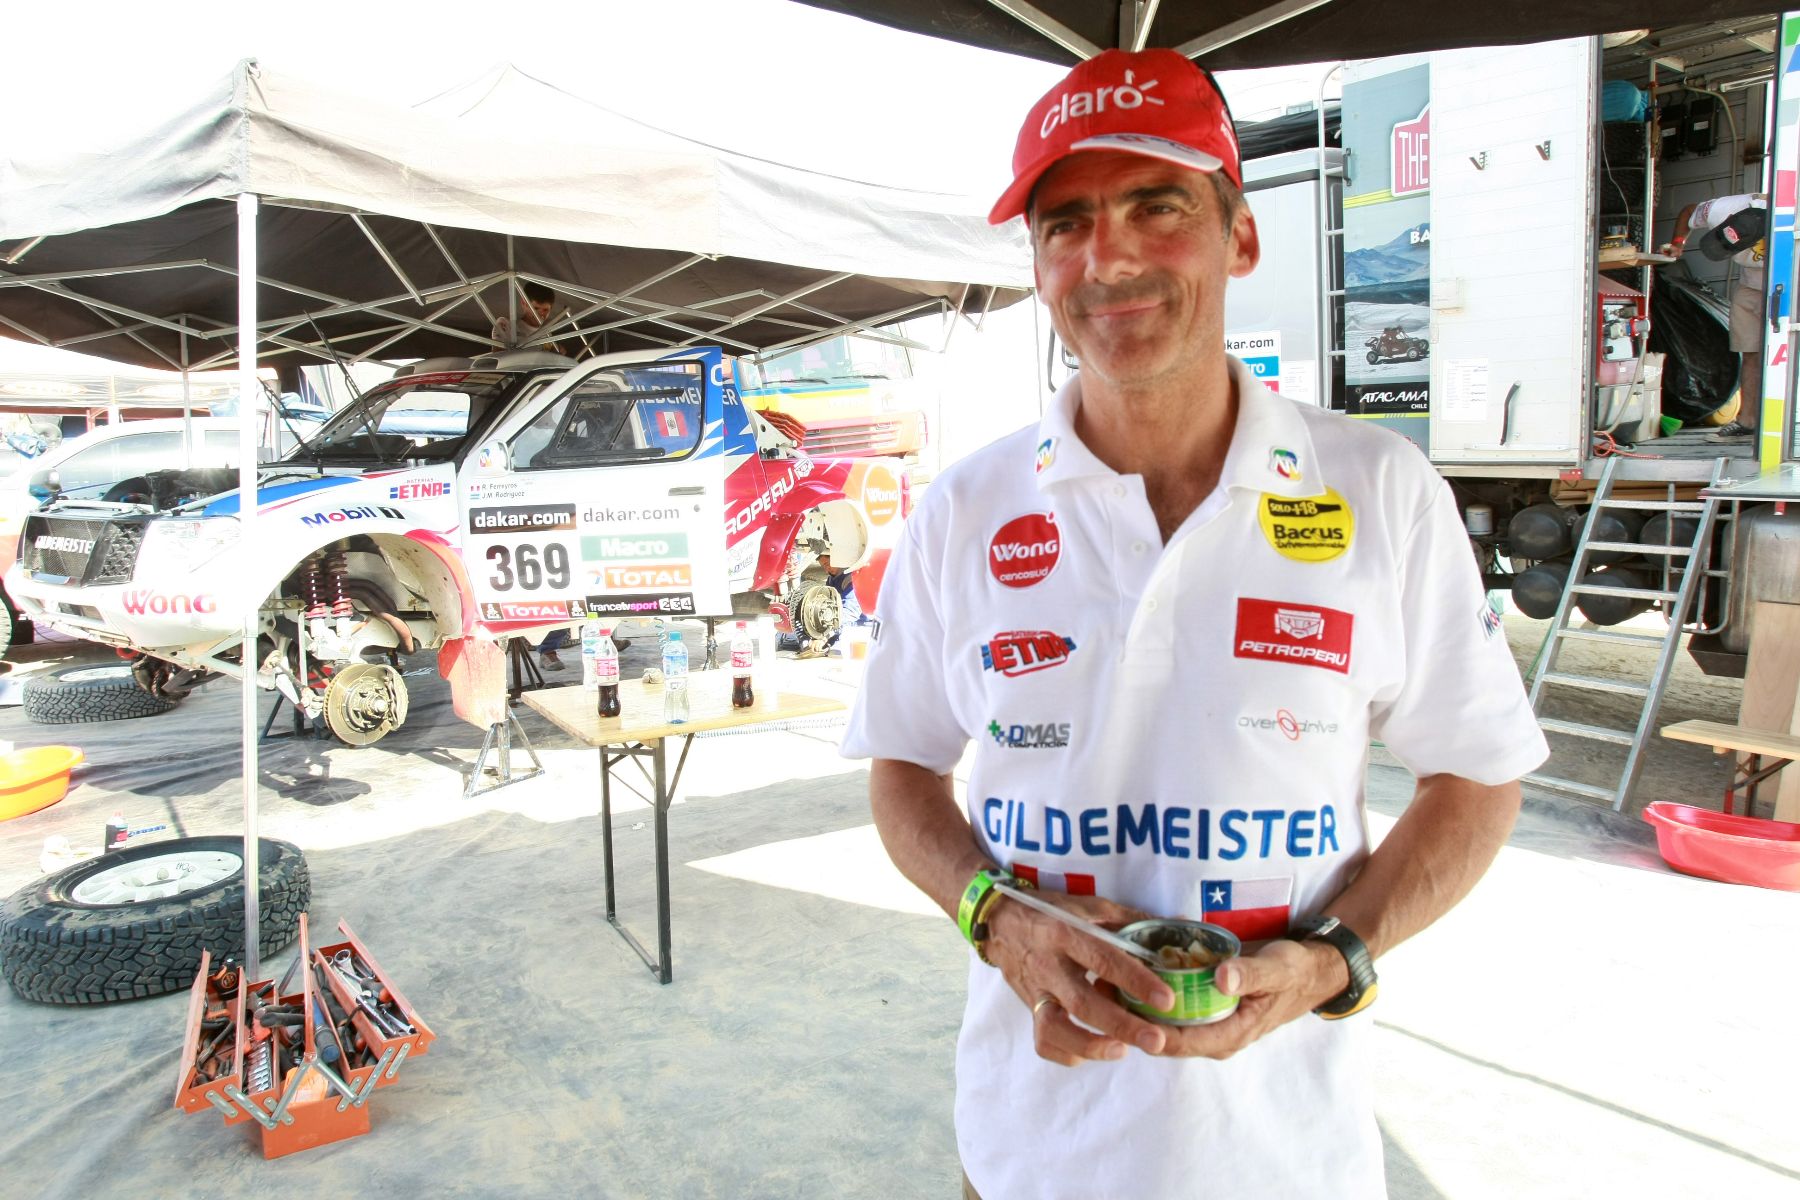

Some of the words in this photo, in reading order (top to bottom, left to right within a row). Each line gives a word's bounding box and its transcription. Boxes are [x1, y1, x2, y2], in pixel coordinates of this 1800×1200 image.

[1041, 85, 1144, 139] claro
[1398, 131, 1429, 188] THE
[1359, 390, 1429, 404] ATACAMA
[398, 482, 443, 500] ETNA
[724, 467, 795, 537] ROPERU
[300, 507, 377, 529] Mobil
[474, 510, 571, 528] dakar.com
[583, 507, 680, 522] dakar.com
[600, 538, 669, 556] Macro
[992, 539, 1058, 562] Wong
[486, 543, 571, 592] 369
[607, 569, 690, 585] TOTAL
[999, 566, 1050, 582] cencosud
[122, 589, 217, 616] Wong
[502, 605, 567, 617] TOTAL
[988, 636, 1070, 672] ETNA
[1239, 640, 1348, 666] PETROPERU
[1007, 723, 1071, 743] DMAS
[984, 797, 1340, 861] GILDEMEISTER
